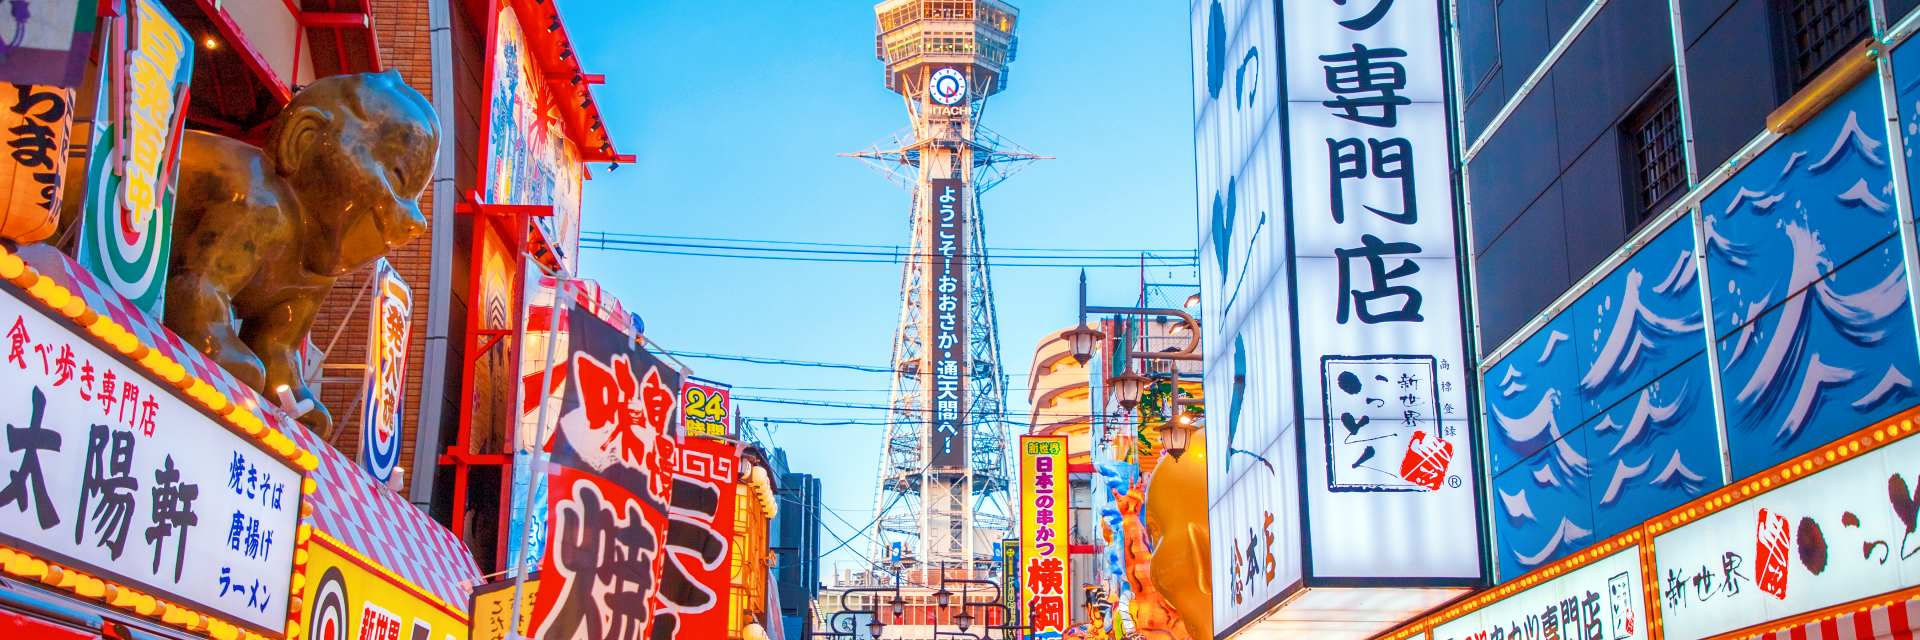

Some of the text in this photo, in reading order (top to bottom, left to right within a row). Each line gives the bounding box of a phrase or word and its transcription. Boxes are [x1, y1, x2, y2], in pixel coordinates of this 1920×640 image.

[6, 315, 160, 438] 食べ歩き専門店
[686, 388, 727, 421] 24
[1397, 373, 1427, 428] 新世界
[0, 385, 199, 584] 太陽軒
[228, 450, 285, 512] 焼きそば
[1035, 456, 1055, 556] 日本一の串かつ
[227, 510, 274, 563] 唐揚げ
[219, 566, 272, 614] ラーメン
[1665, 551, 1750, 617] 新世界
